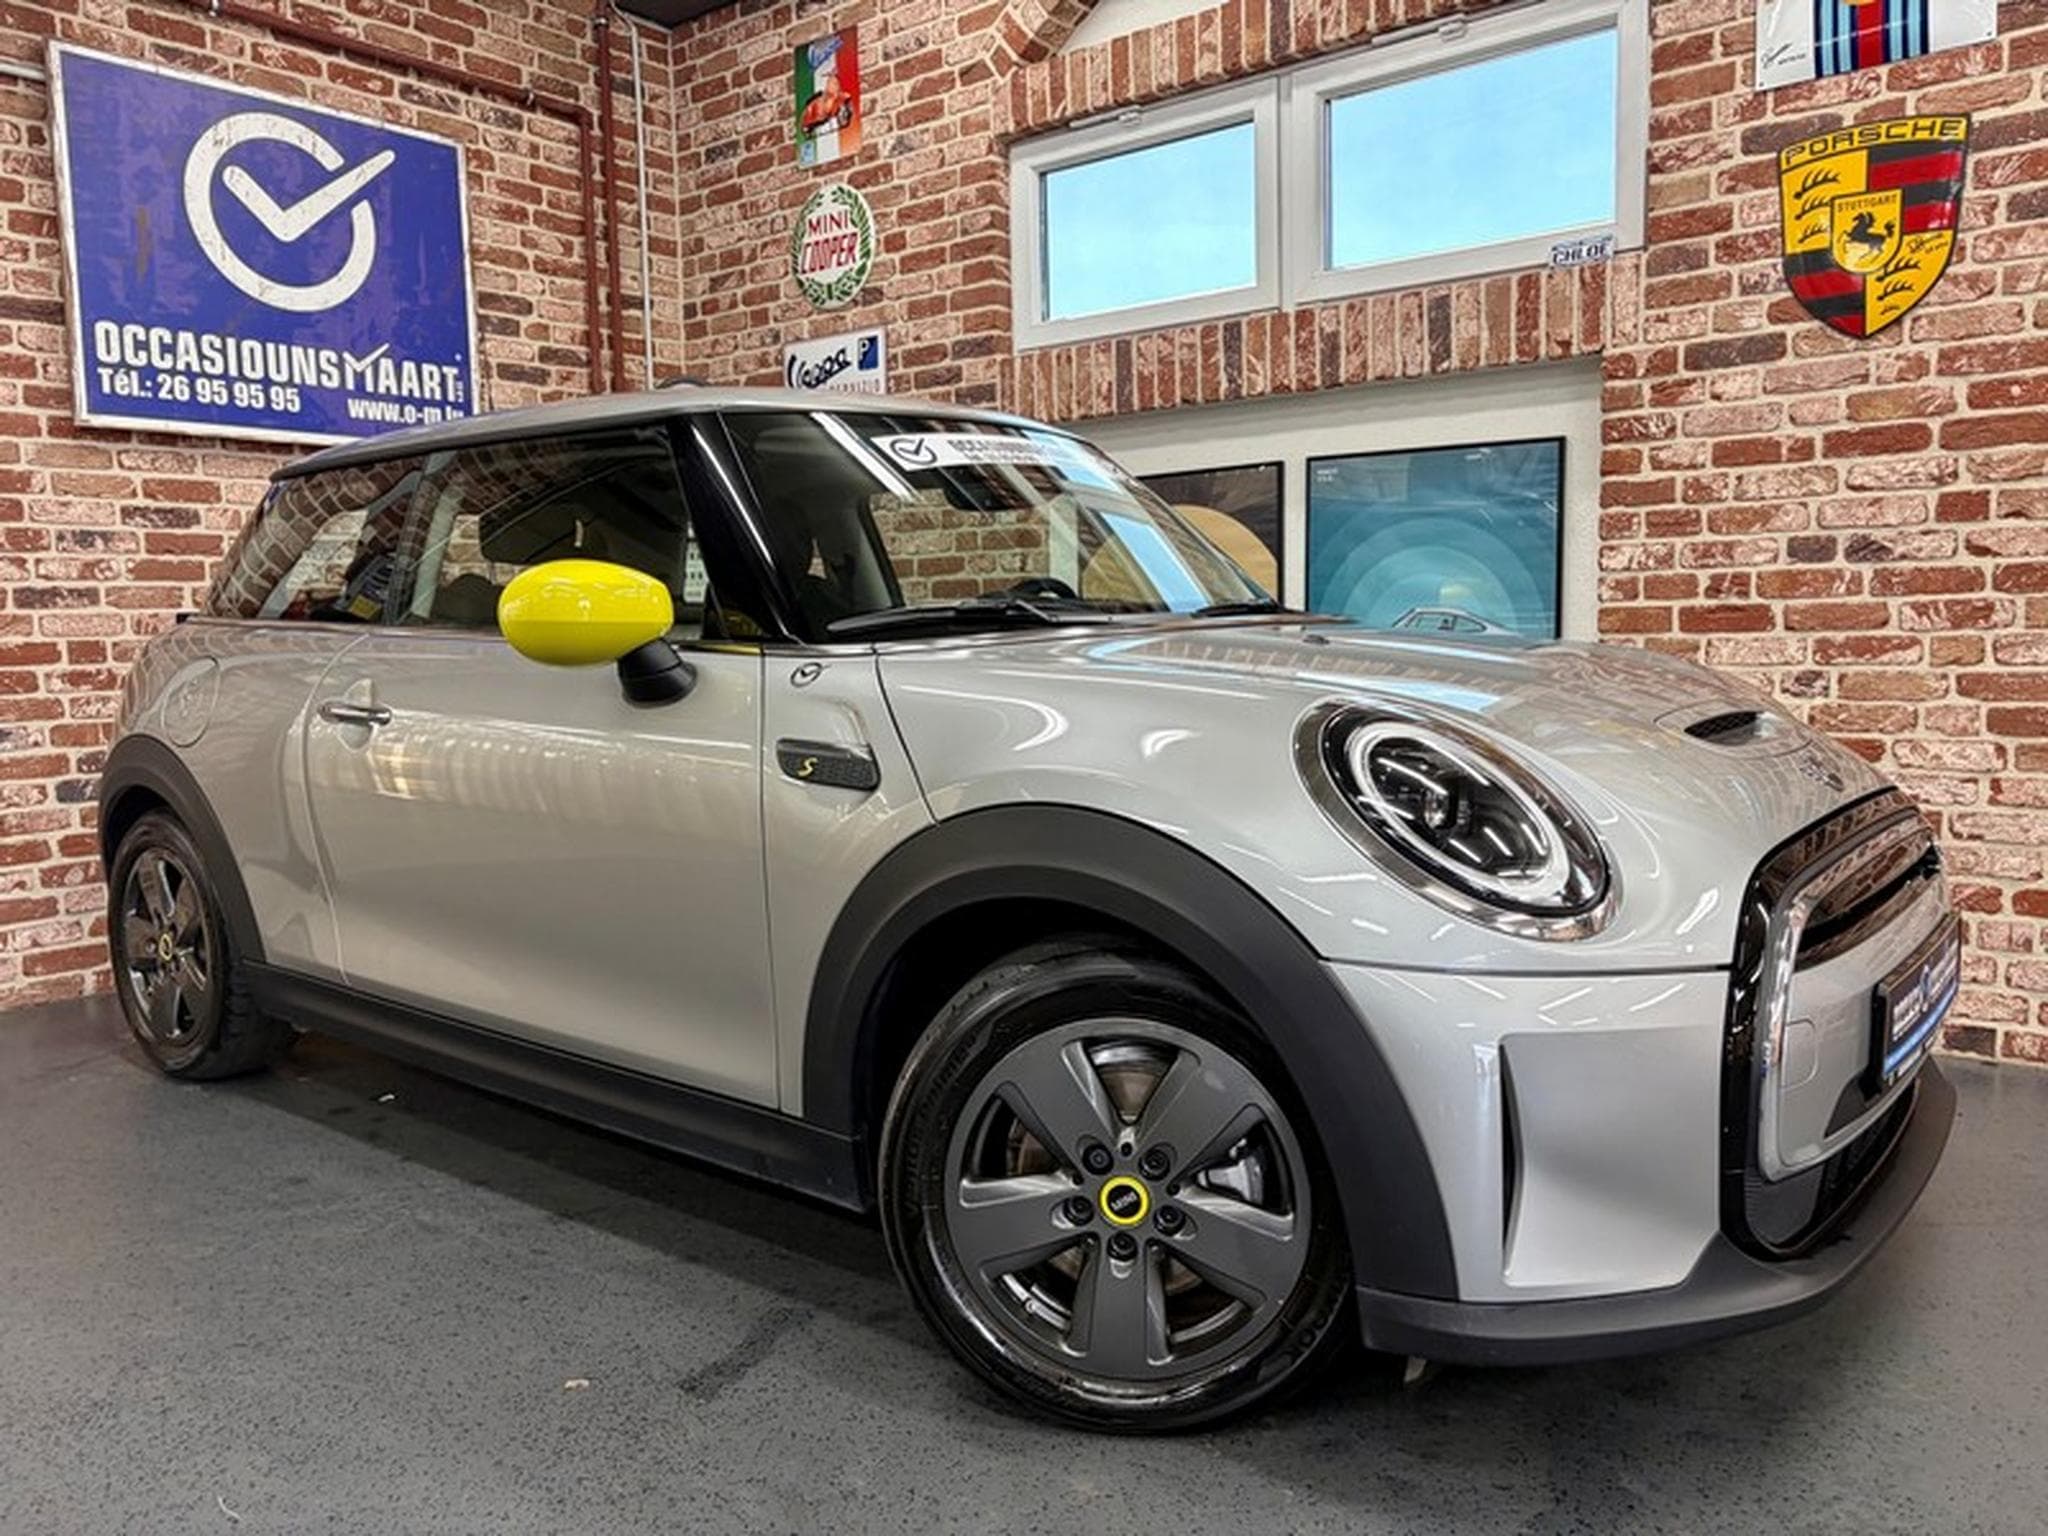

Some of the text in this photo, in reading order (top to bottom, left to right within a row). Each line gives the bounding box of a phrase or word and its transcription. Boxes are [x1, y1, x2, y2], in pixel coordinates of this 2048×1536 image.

[1785, 119, 1963, 165] PORSCHE
[808, 209, 849, 236] MINI
[1837, 193, 1897, 213] STUTTGART
[801, 231, 857, 274] COOPER
[93, 319, 459, 403] OCCASIOUNSMAART
[787, 346, 852, 390] Vespa
[97, 367, 301, 414] Tél.: 26 95 95 95
[348, 398, 464, 425] www.o-mlu
[797, 757, 819, 777] S
